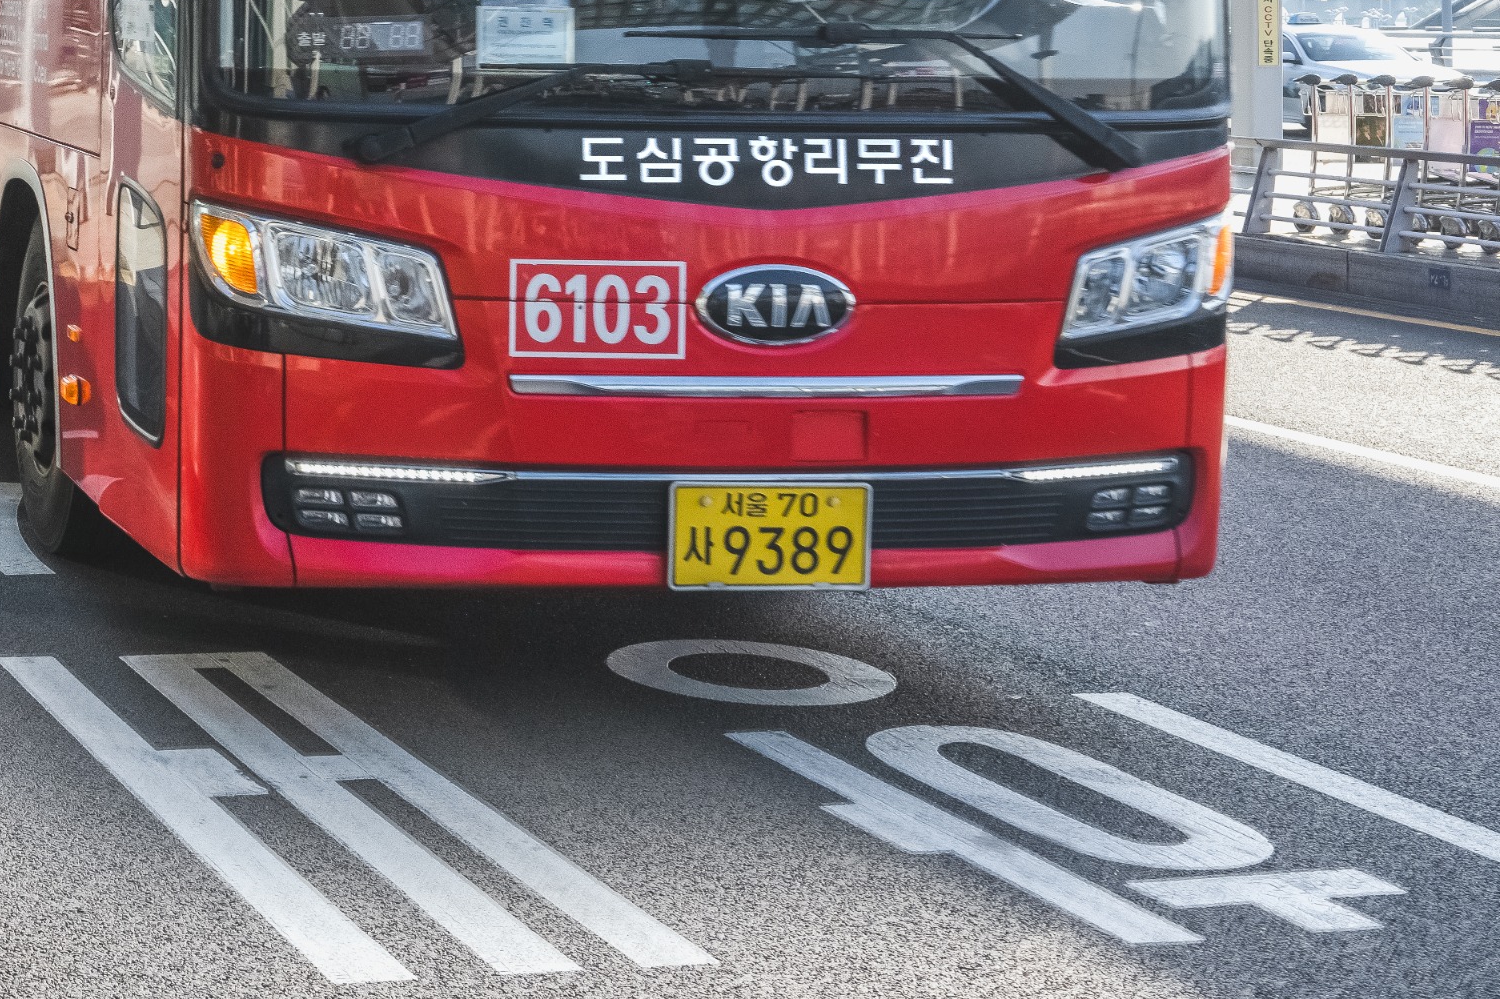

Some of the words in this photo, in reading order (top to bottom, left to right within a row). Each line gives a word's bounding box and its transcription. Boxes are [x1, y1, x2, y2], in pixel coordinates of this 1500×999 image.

[1264, 5, 1273, 37] CCTV
[296, 31, 327, 47] 출발
[1263, 39, 1274, 63] 단속중
[579, 135, 955, 187] 도심공항리무진
[524, 273, 671, 345] 6103
[725, 283, 832, 328] KIA
[721, 492, 769, 518] 서울
[777, 492, 819, 518] 70
